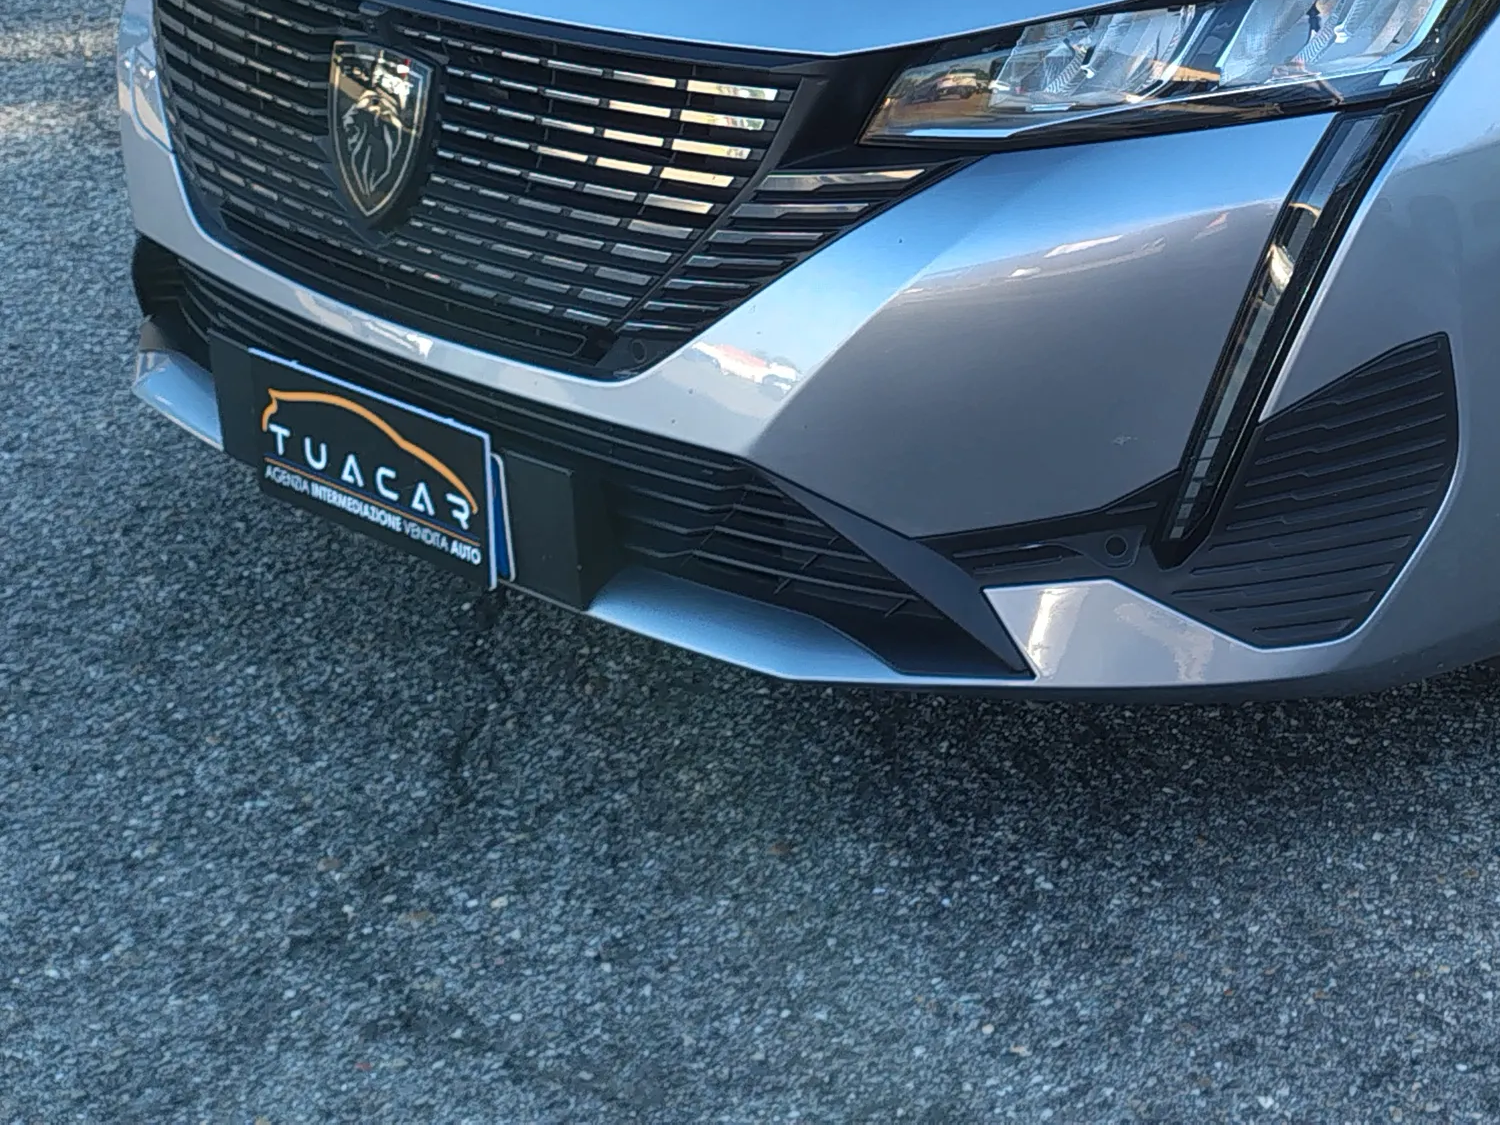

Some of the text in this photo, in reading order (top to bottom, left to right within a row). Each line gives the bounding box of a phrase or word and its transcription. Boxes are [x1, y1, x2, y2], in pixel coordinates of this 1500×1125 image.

[265, 464, 481, 565] AGENZIA INTERMEDIAZIONE VENDITA AUTO
[269, 424, 472, 530] TUACAR
